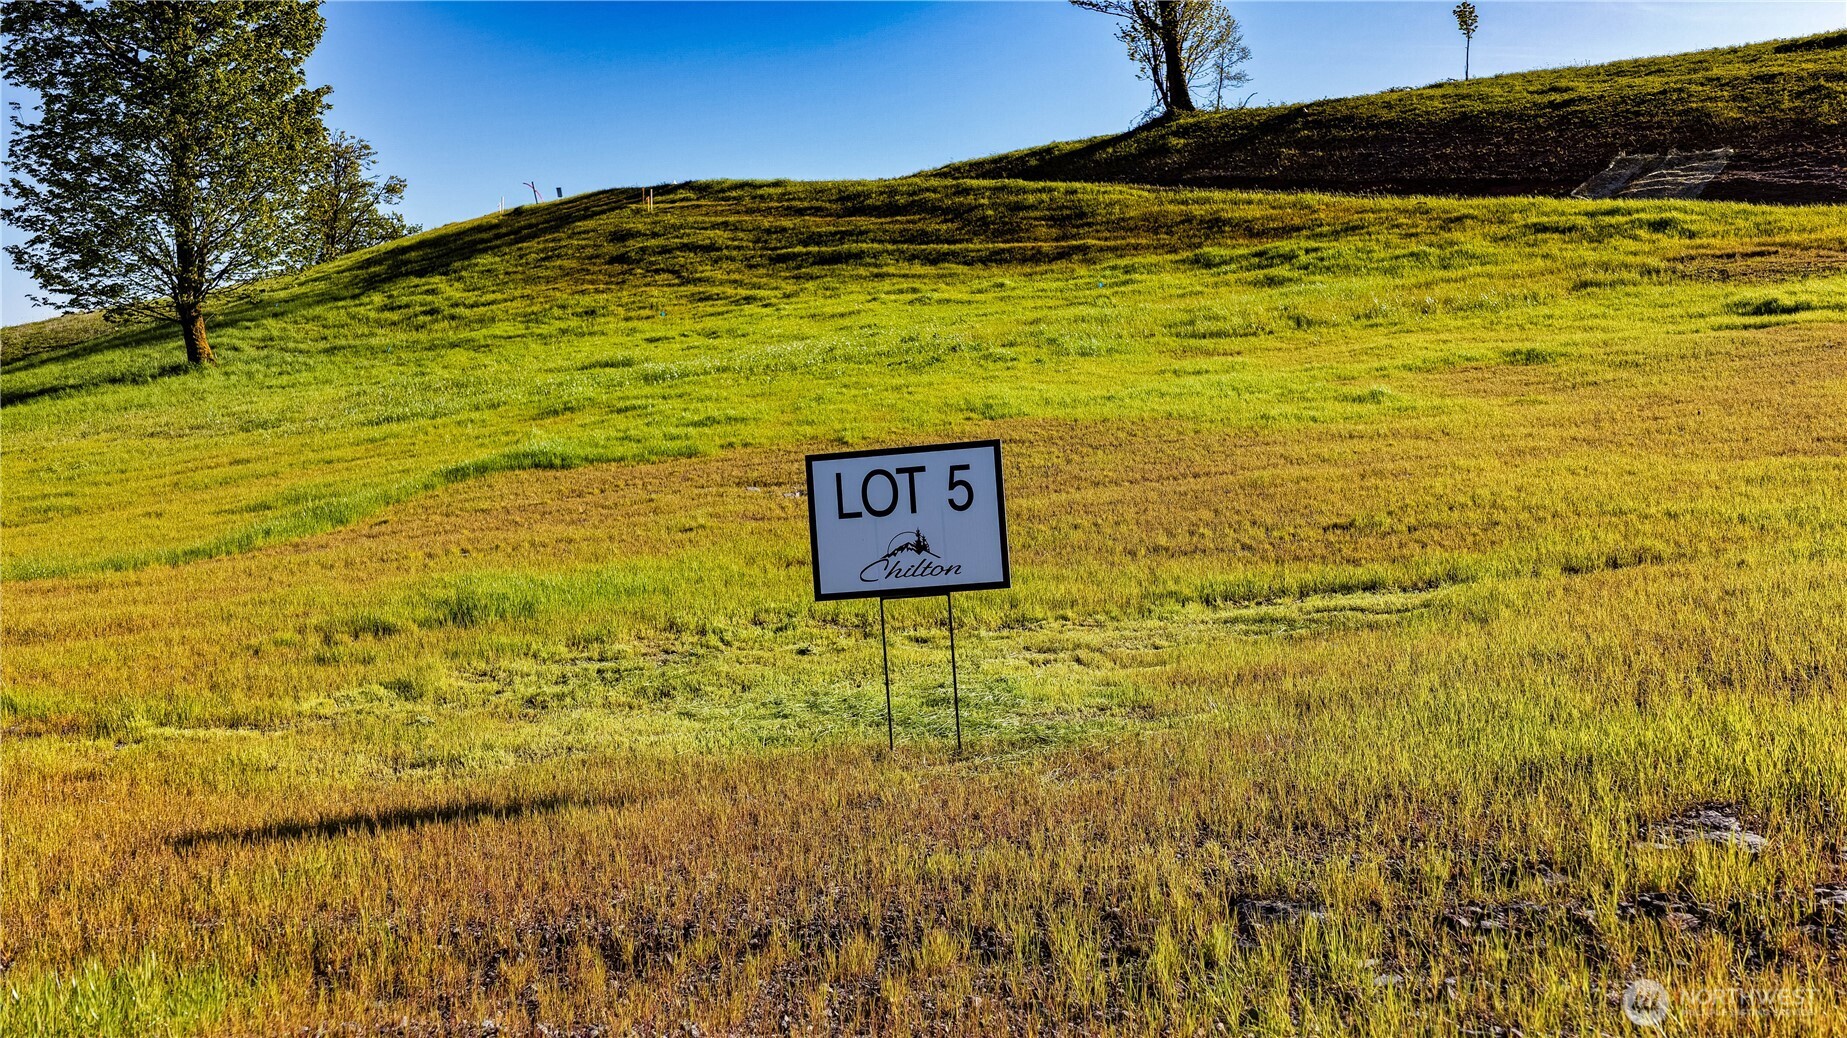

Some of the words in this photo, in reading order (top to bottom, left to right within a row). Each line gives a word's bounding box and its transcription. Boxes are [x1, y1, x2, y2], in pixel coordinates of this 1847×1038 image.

[835, 465, 926, 520] LOT
[947, 463, 974, 512] 5
[859, 558, 962, 582] Chilton
